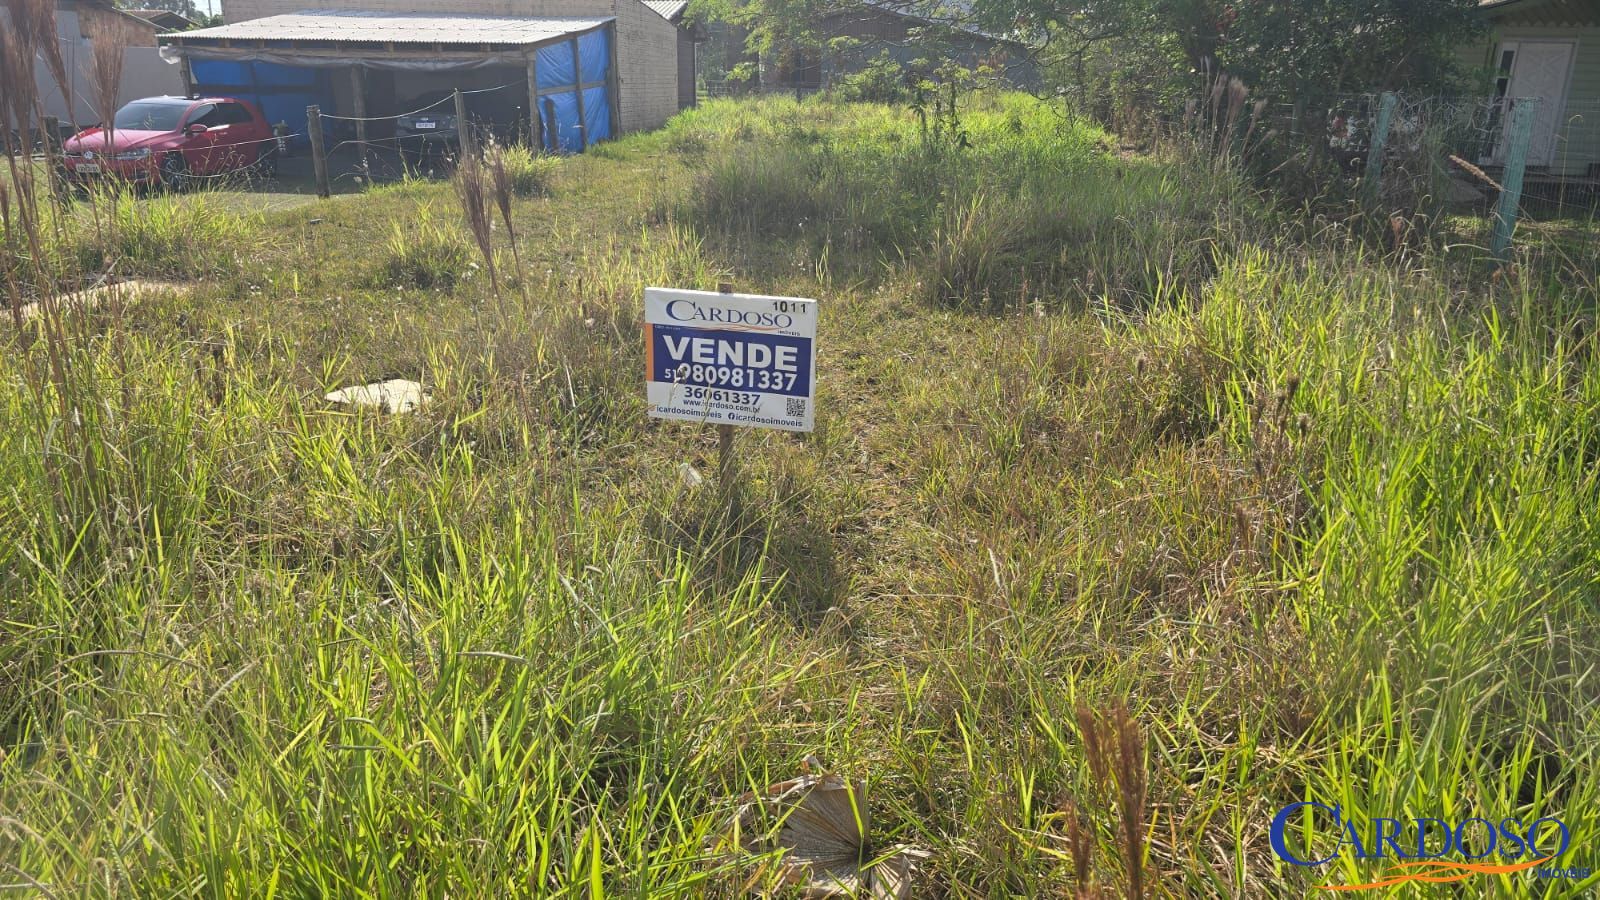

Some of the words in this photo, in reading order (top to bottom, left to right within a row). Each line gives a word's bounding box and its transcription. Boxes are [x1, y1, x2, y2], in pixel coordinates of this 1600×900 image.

[666, 299, 792, 329] CARDOSO
[772, 301, 807, 314] 1011
[663, 334, 798, 372] VENDE
[677, 363, 798, 391] 980981337
[685, 386, 761, 406] 36061337
